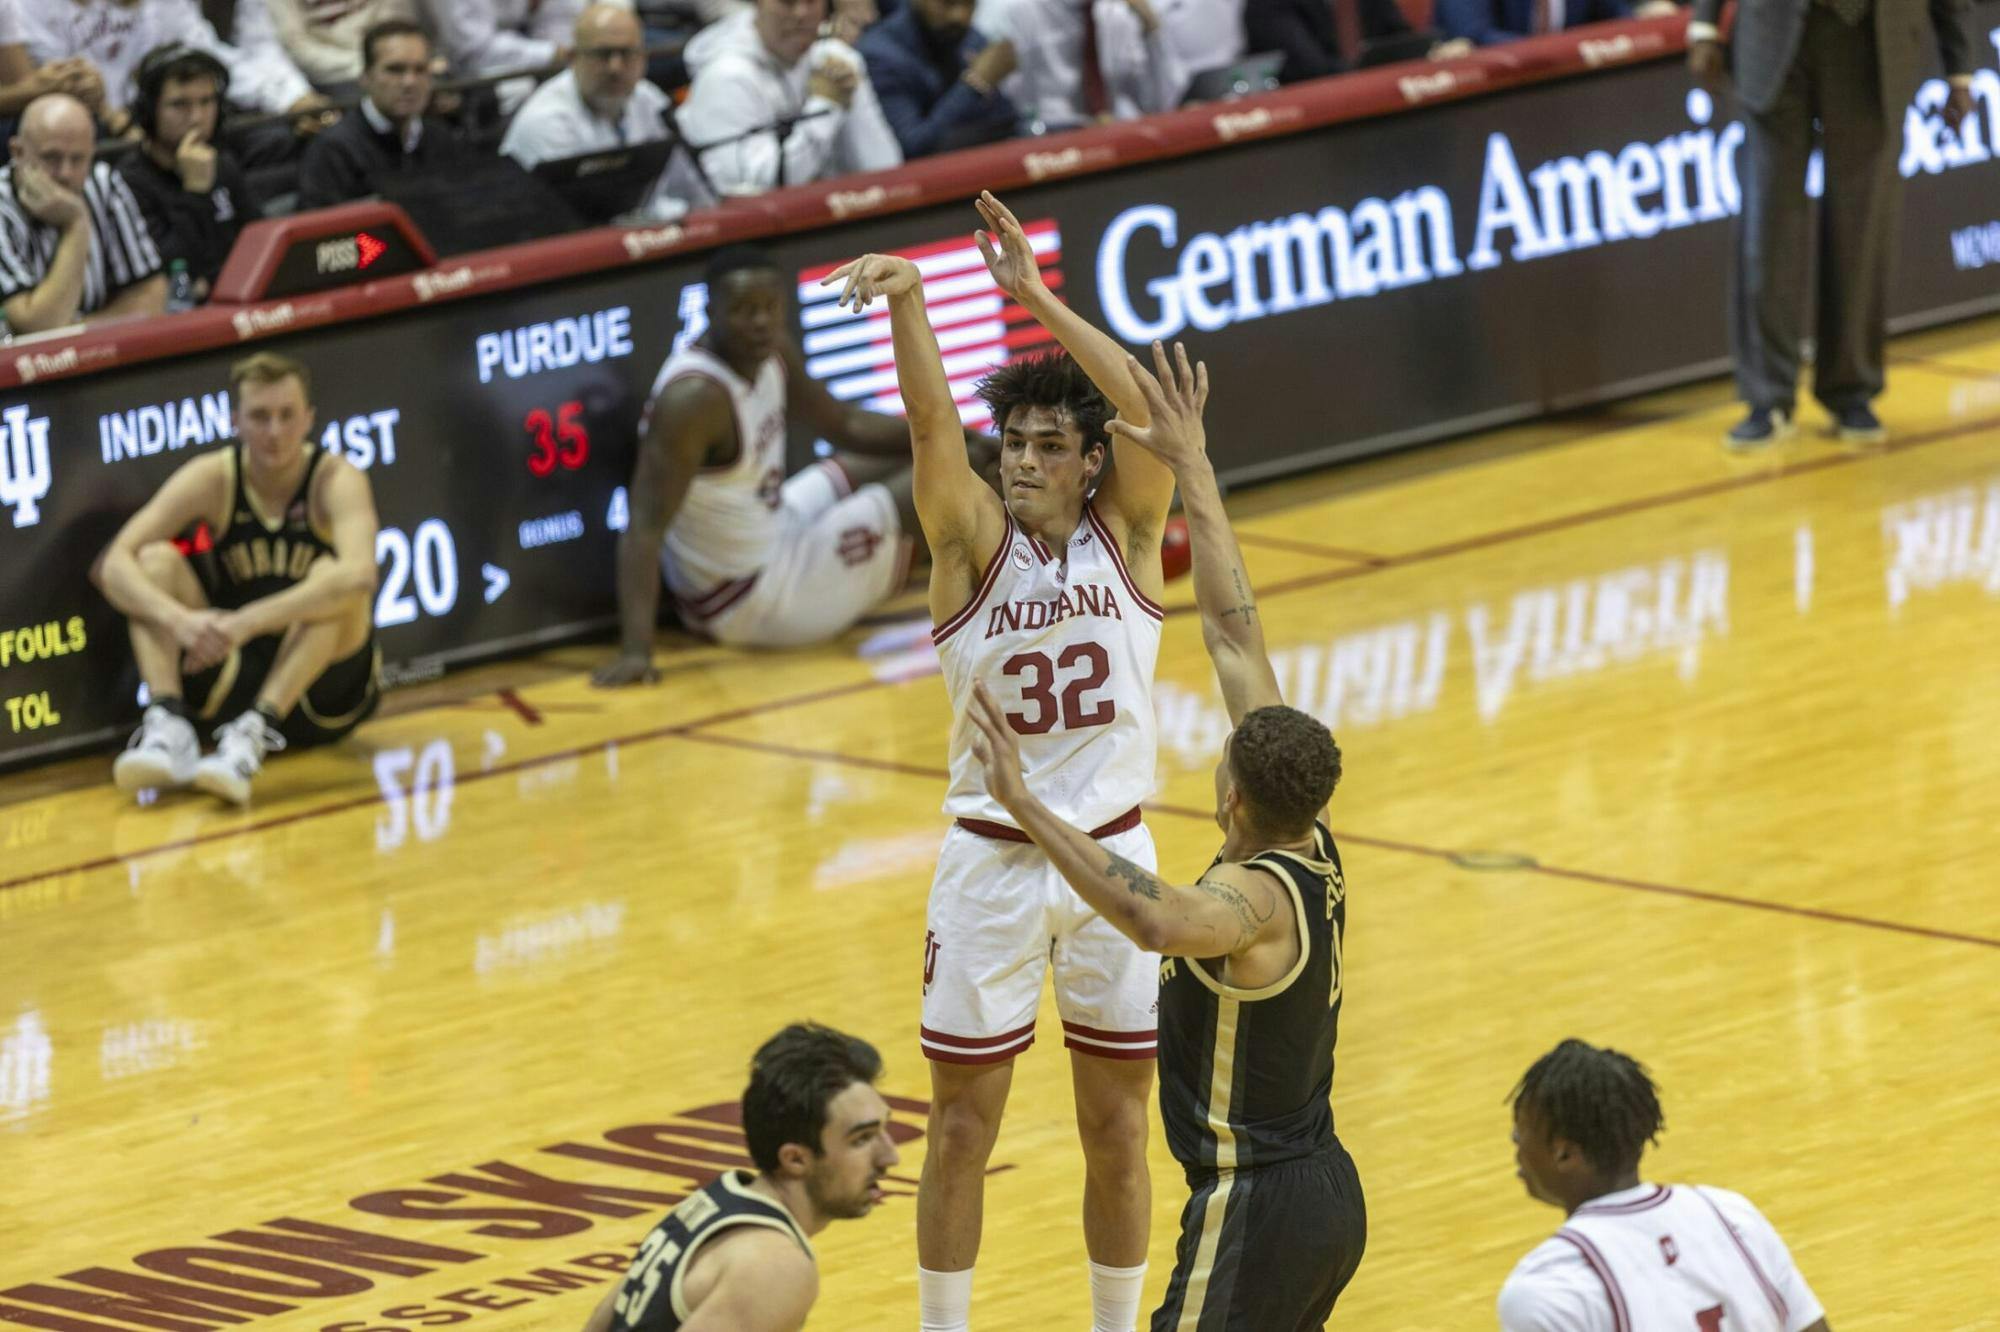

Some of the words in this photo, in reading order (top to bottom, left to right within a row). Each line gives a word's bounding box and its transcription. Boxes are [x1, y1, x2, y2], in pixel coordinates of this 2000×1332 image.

[1095, 184, 1464, 346] German
[1467, 88, 1824, 270] Americ
[476, 305, 634, 384] PURDUE
[99, 390, 239, 464] INDIAN
[321, 408, 400, 470] 1ST
[524, 400, 590, 478] 35
[374, 517, 459, 629] 20
[985, 584, 1122, 640] INDIANA
[0, 615, 87, 668] FOULS
[5, 691, 61, 733] TOL
[1002, 641, 1116, 736] 32
[614, 1227, 682, 1328] 25
